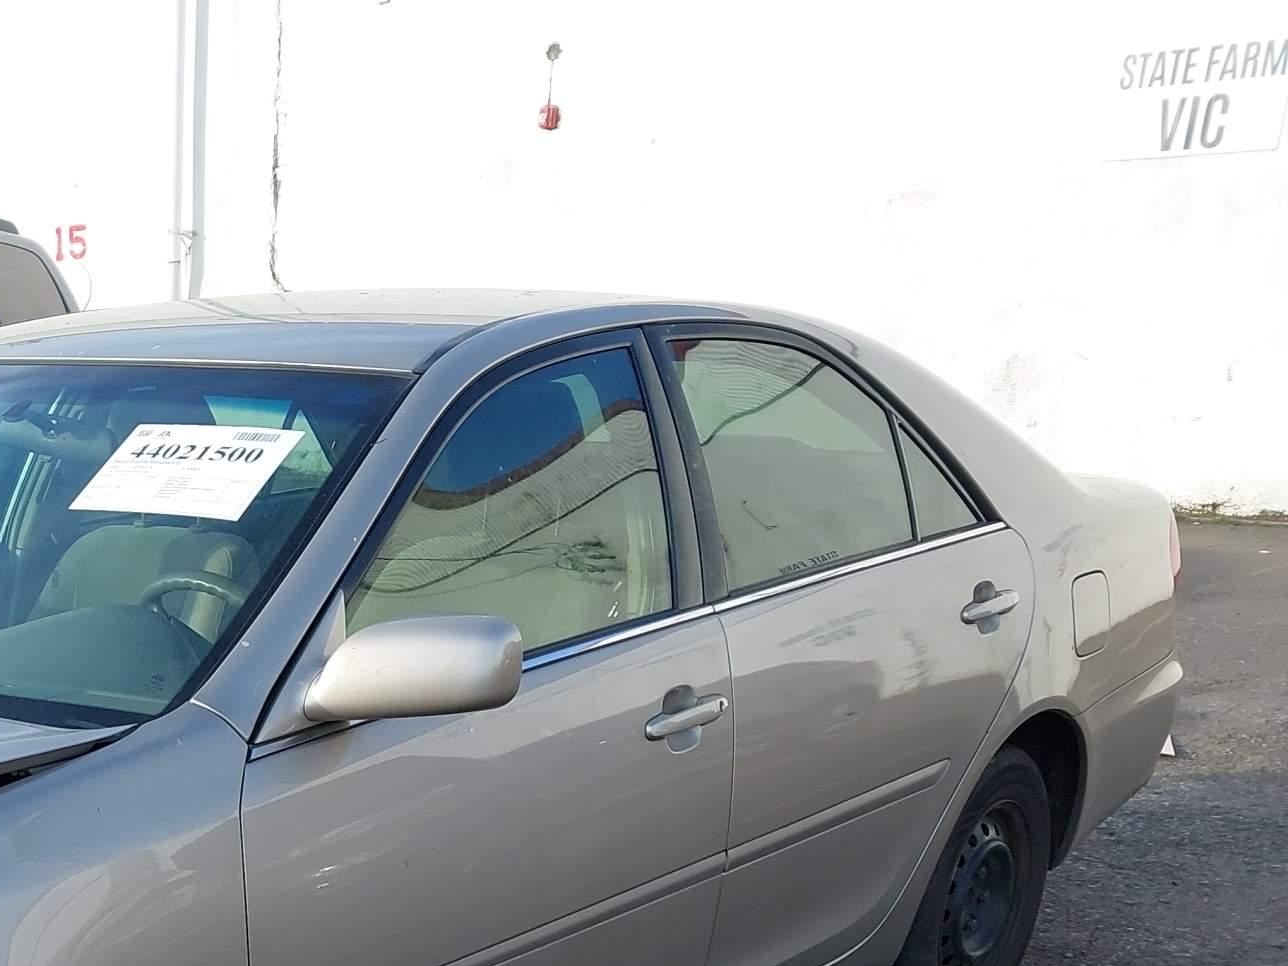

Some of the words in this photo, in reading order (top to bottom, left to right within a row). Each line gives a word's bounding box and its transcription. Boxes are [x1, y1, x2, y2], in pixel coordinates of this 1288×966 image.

[1120, 46, 1201, 90] STATE
[1203, 38, 1288, 83] FARM
[1160, 93, 1231, 152] VIC
[55, 224, 87, 262] 15
[130, 443, 264, 464] 44021500
